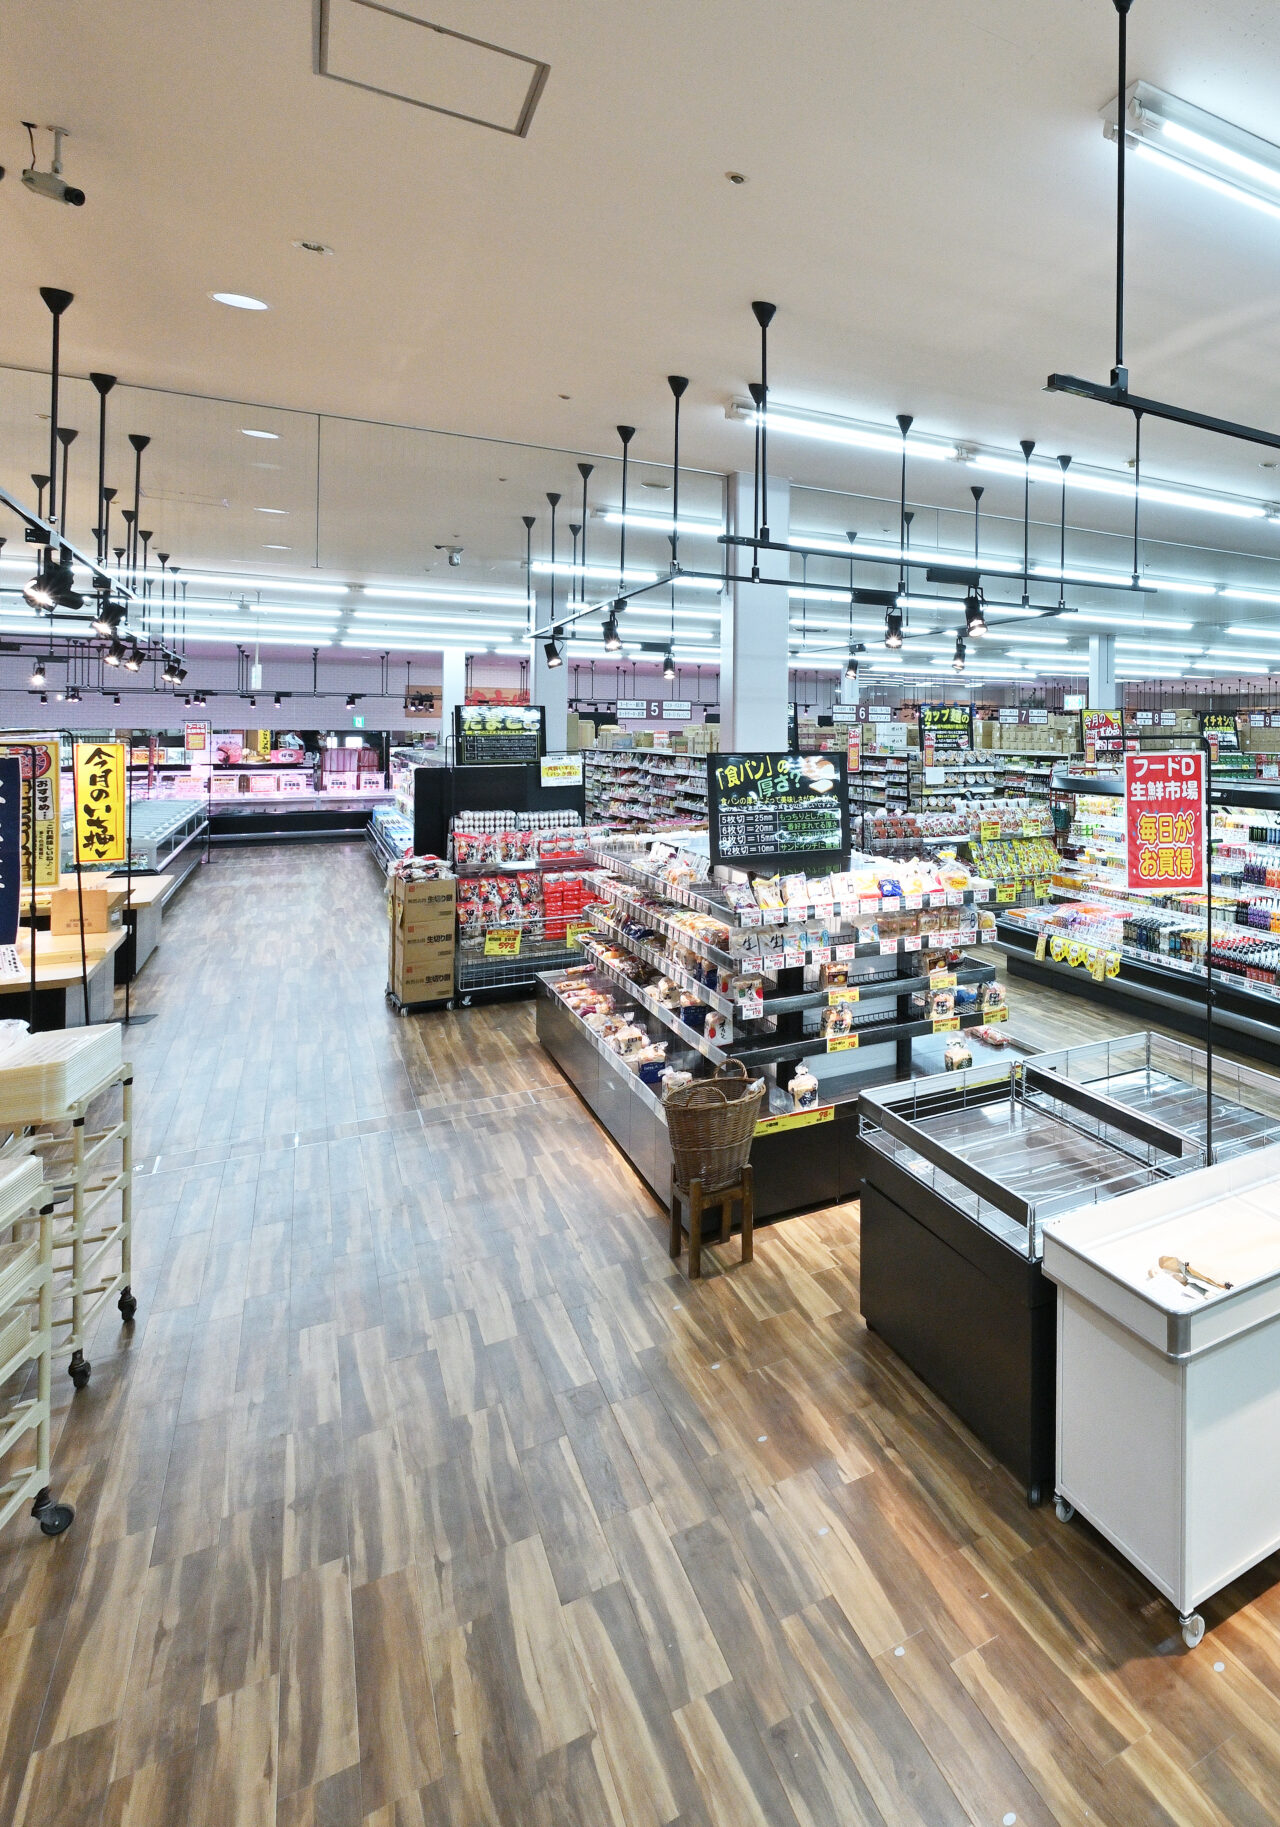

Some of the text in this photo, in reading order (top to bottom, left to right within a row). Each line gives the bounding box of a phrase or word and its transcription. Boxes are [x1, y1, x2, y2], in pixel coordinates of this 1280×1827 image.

[650, 702, 659, 716] 5
[859, 707, 866, 719] 6
[924, 708, 969, 724] カップ麺の
[1021, 710, 1027, 722] 7
[1084, 713, 1106, 728] 今月の
[1154, 713, 1159, 724] 8
[1265, 716, 1270, 727] 9
[715, 755, 789, 791] 「食パン」の
[1132, 757, 1195, 778] フードD
[1130, 780, 1199, 801] 生鮮市場
[82, 746, 115, 859] 今月のいち押し
[1138, 813, 1195, 845] 毎日が
[1140, 847, 1193, 877] お買得
[498, 941, 516, 950] 598
[743, 936, 757, 951] 生
[770, 934, 783, 949] 生
